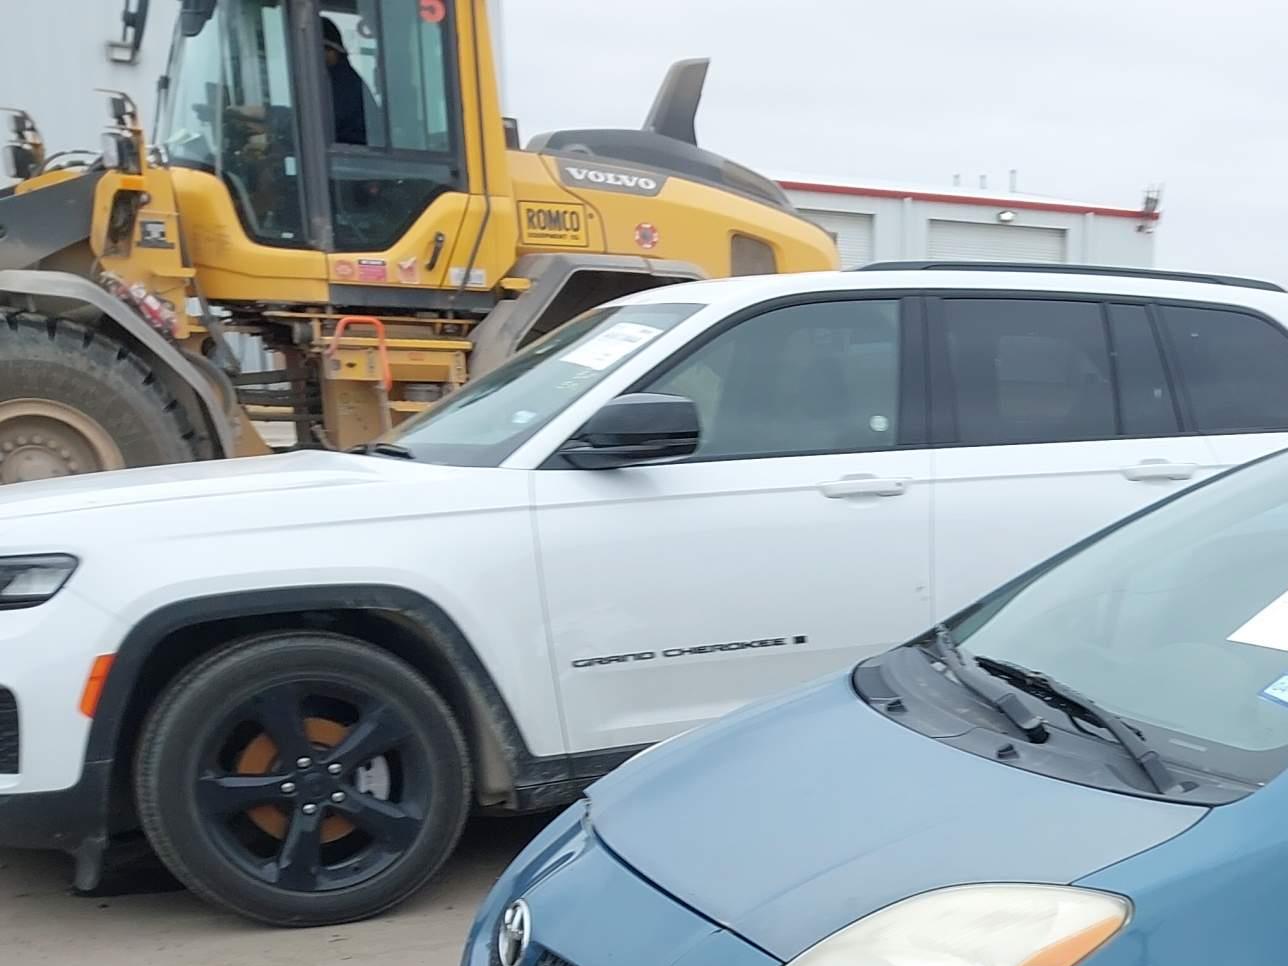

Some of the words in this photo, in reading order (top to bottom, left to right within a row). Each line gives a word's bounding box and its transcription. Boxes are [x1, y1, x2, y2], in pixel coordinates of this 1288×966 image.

[565, 167, 657, 190] VOLVO
[526, 208, 580, 232] ROMCO
[571, 651, 656, 668] GRAND
[661, 637, 788, 658] CHEROKEE
